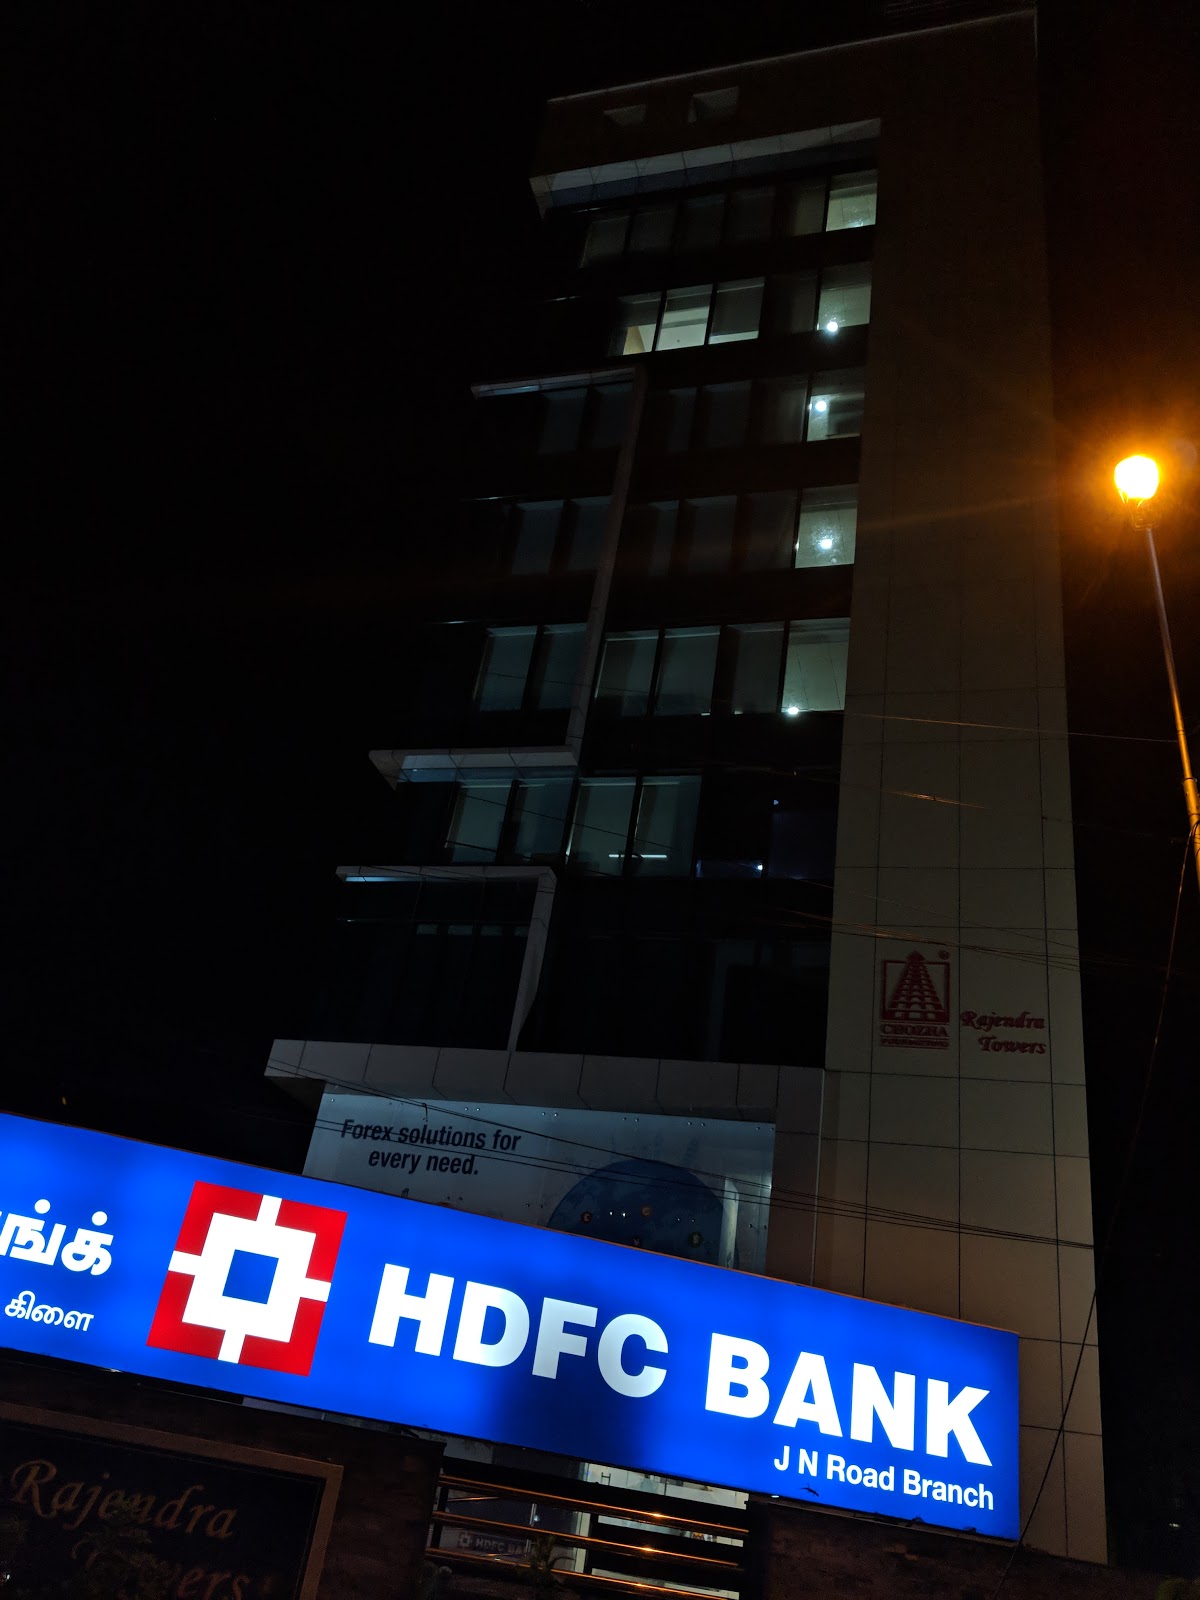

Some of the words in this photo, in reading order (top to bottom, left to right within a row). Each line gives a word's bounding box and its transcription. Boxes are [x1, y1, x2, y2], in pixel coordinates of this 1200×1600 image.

[960, 1011, 1045, 1032] Rajendra
[977, 1036, 1047, 1054] Towers
[341, 1118, 393, 1141] Forex
[398, 1124, 487, 1150] solutions
[492, 1129, 522, 1151] for
[368, 1150, 422, 1174] every
[426, 1153, 479, 1176] need.
[4, 1290, 95, 1332] கிளை
[368, 1263, 669, 1398] HDFC
[704, 1332, 993, 1467] BANK
[773, 1445, 790, 1471] J
[798, 1448, 819, 1477] N
[826, 1453, 895, 1492] Road
[903, 1468, 994, 1511] Branch
[9, 1457, 240, 1540] Rajendra
